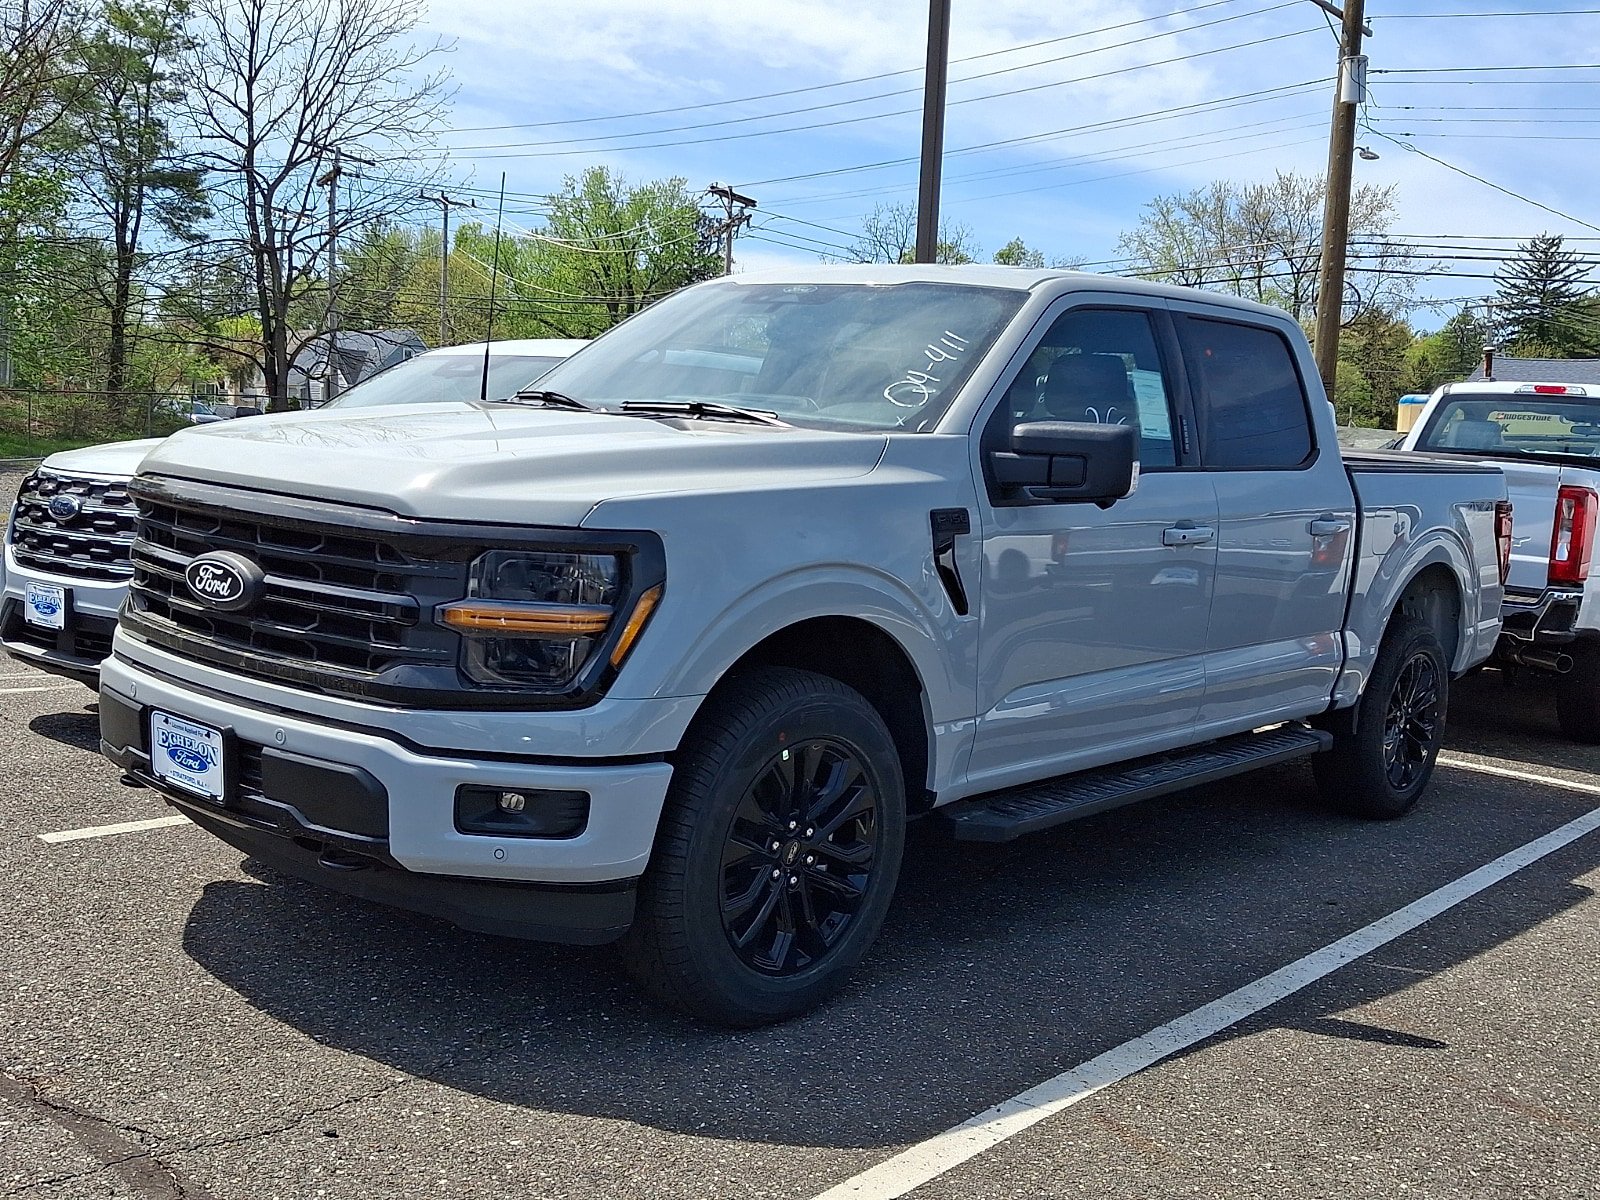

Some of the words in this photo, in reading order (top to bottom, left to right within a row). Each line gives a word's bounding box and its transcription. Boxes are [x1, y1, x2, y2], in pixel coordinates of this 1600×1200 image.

[195, 564, 232, 597] Ford
[157, 727, 218, 766] ECHELON
[174, 749, 201, 769] Ford
